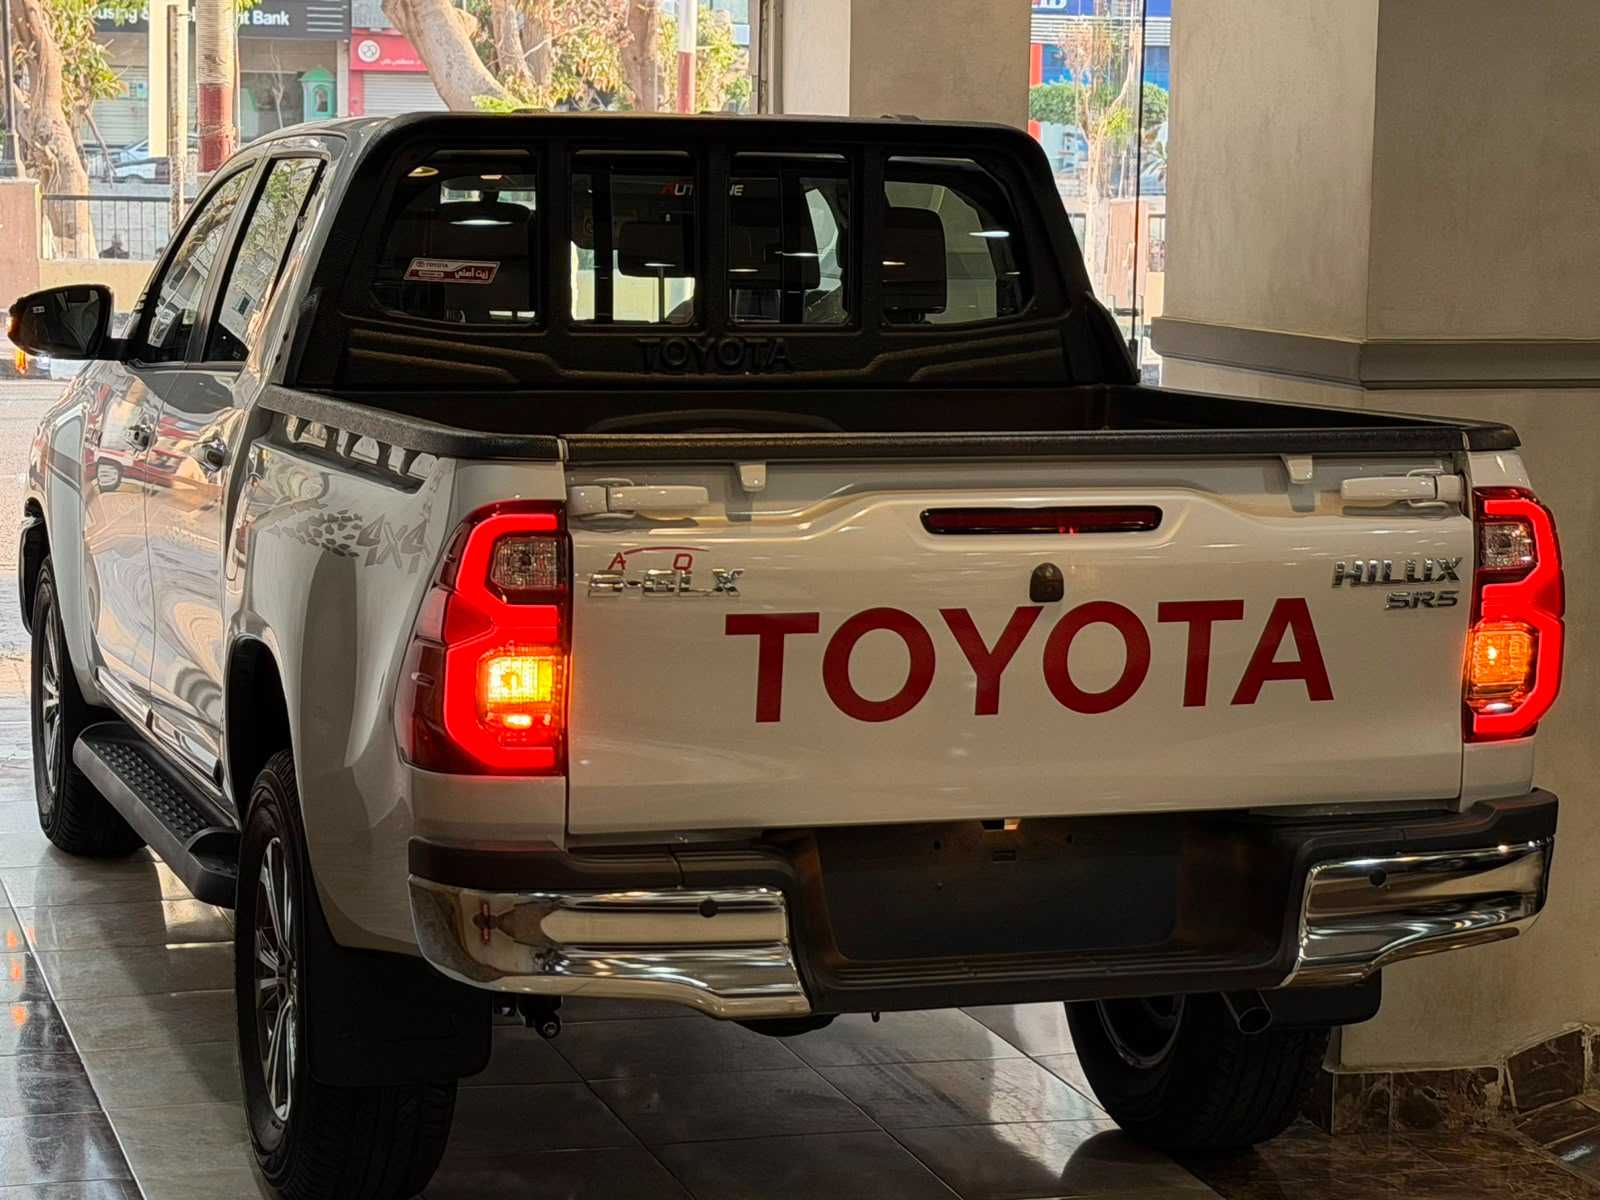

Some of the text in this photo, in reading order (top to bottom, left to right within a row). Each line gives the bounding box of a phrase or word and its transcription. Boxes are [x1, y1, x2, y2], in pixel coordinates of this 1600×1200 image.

[252, 10, 289, 24] Bank
[637, 336, 791, 371] TOYOTA
[1332, 557, 1463, 588] HILUX
[1385, 591, 1460, 610] SR5
[724, 597, 1335, 724] TOYOTA
